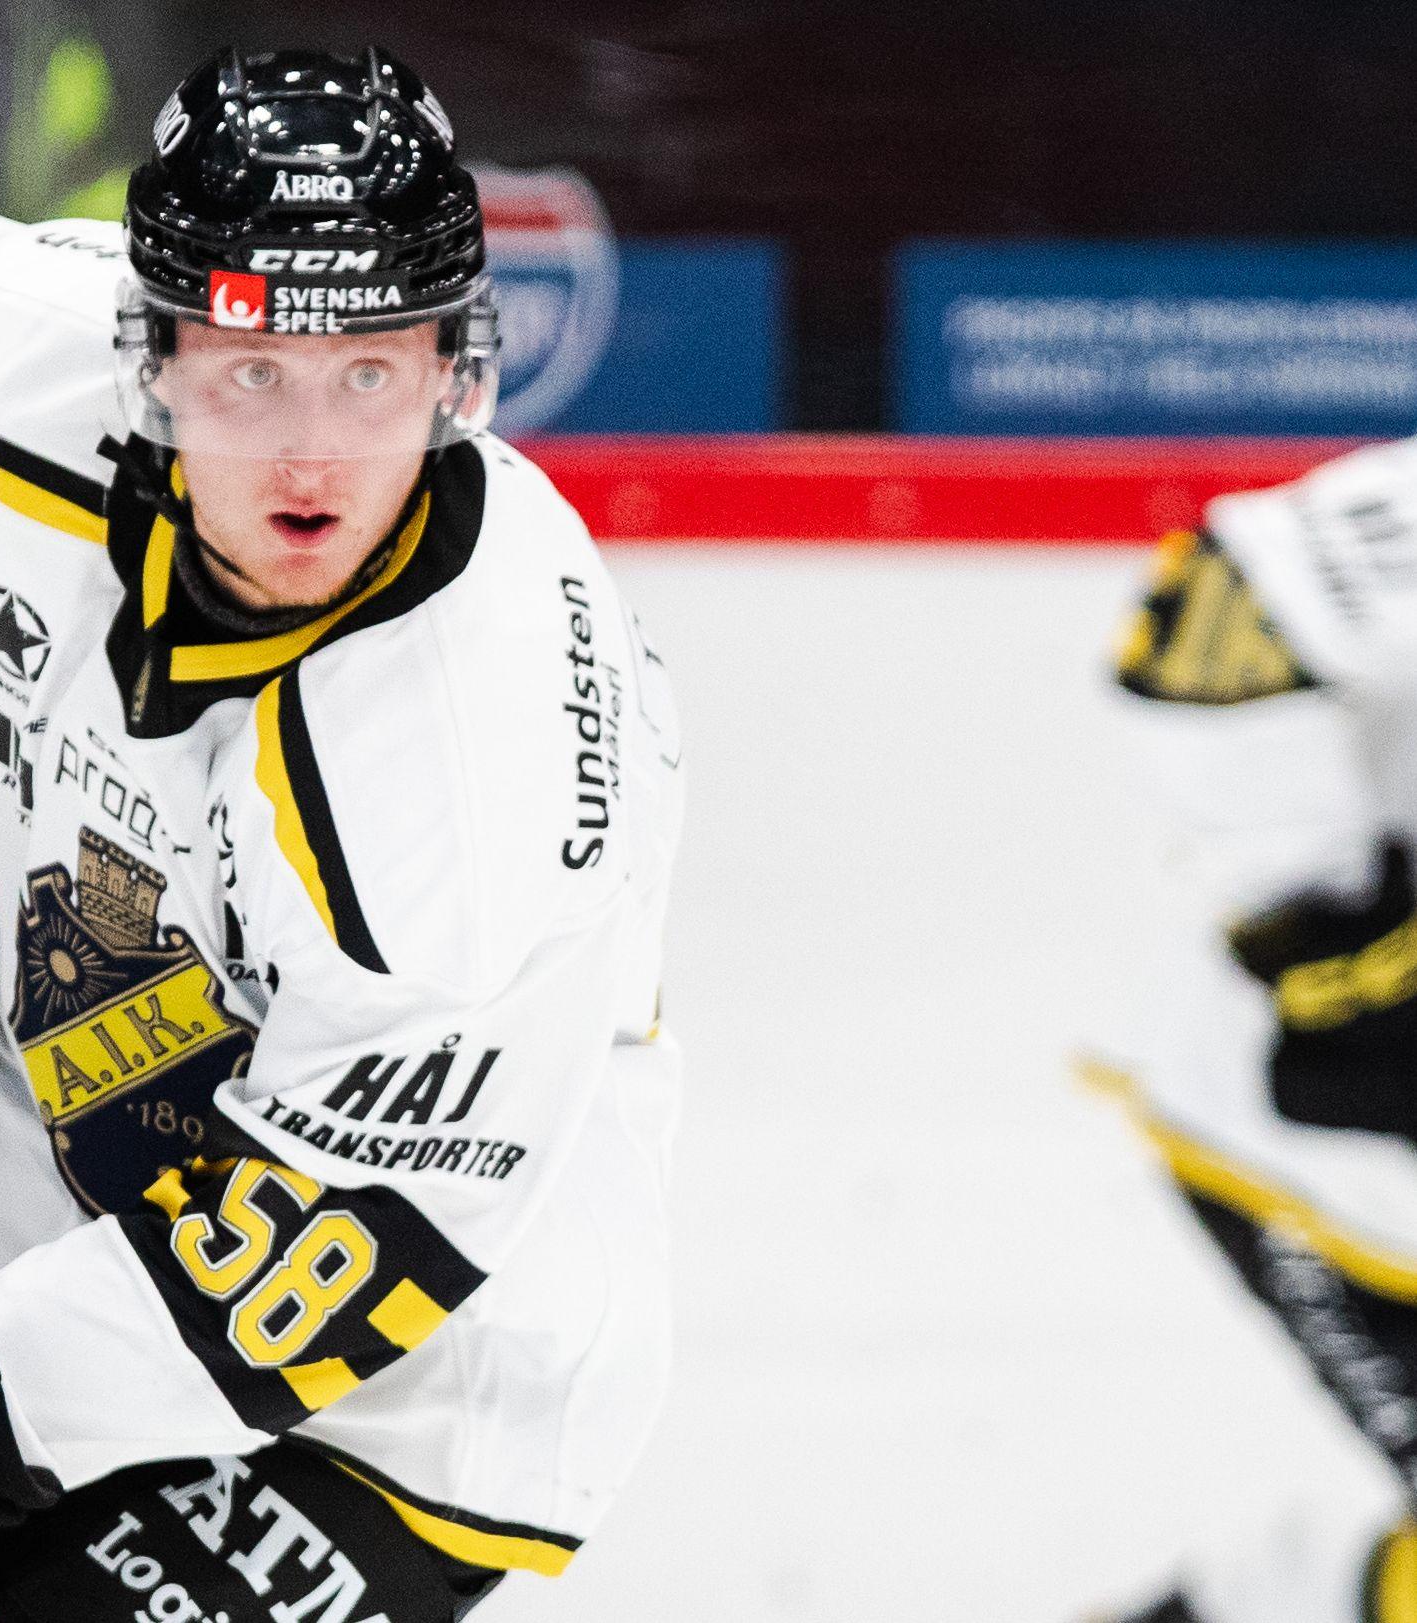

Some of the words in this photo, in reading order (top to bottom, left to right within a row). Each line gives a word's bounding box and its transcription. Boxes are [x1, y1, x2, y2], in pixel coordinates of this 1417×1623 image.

[248, 249, 380, 273] CCM
[273, 285, 403, 311] SVENSKA
[273, 311, 344, 334] SPEL
[559, 574, 610, 870] Sundsten
[320, 1031, 505, 1125] HÅJ
[260, 1096, 528, 1181] TRANSPORTER
[167, 1157, 379, 1370] 58
